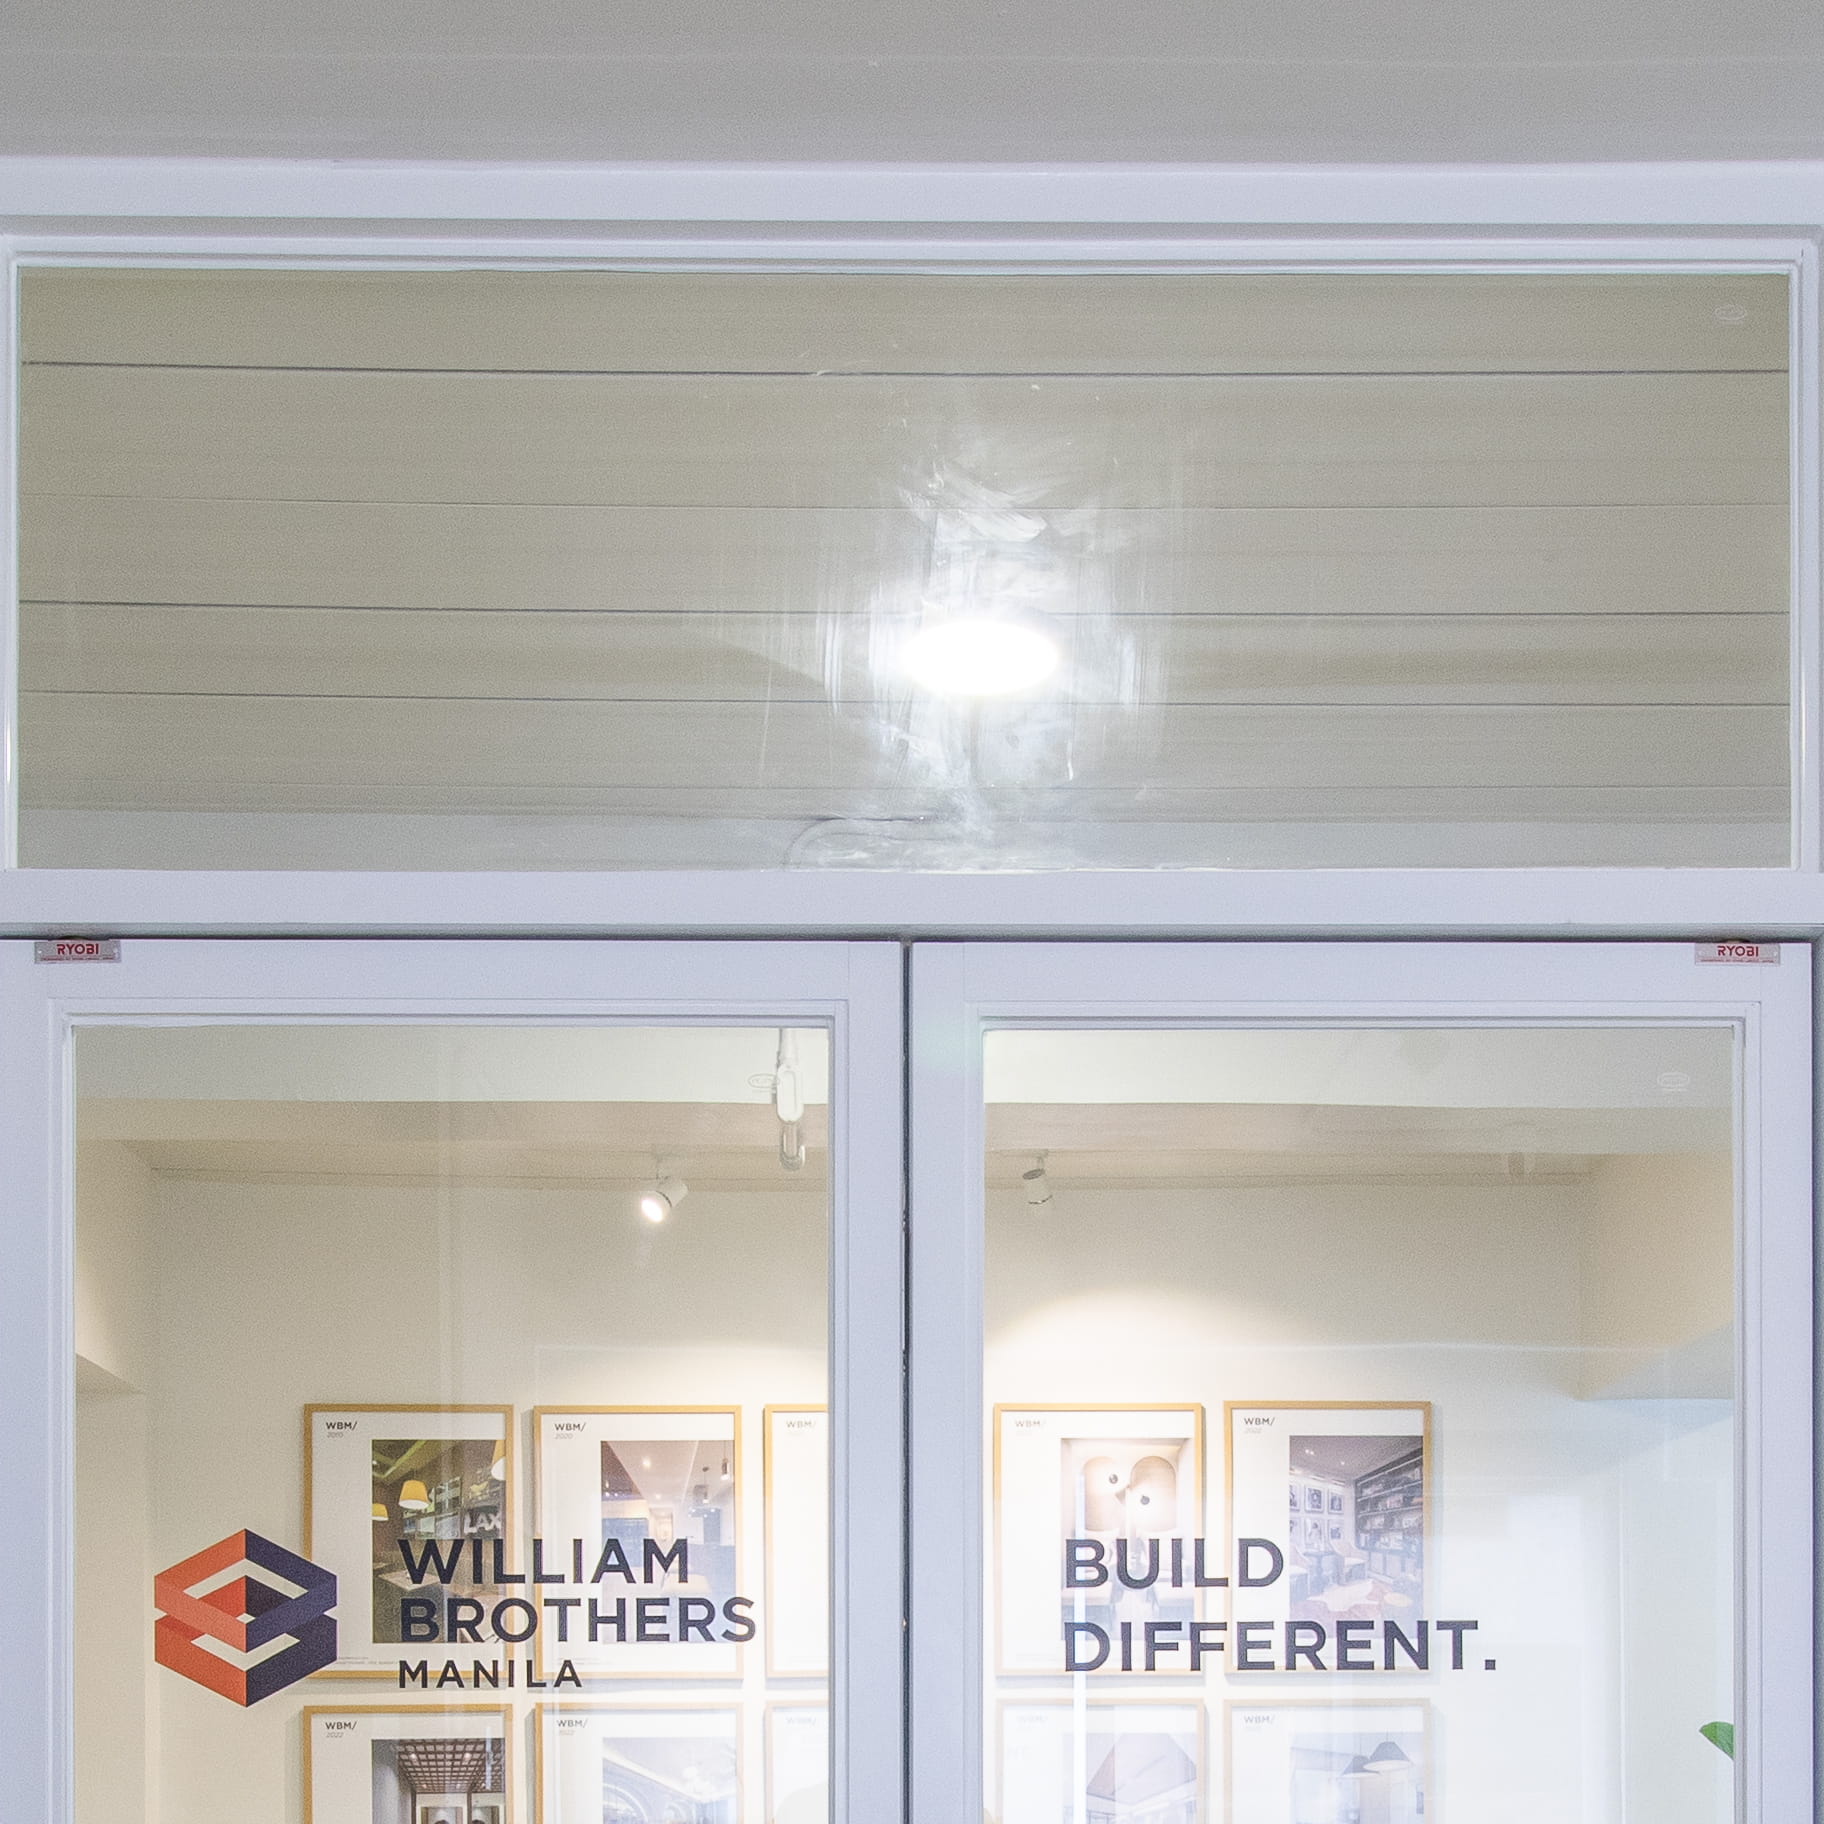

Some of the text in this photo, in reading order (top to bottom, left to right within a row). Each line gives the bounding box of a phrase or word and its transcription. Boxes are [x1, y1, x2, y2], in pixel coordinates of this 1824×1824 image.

[56, 943, 99, 955] RYOBI
[1717, 945, 1759, 957] RYOBI
[326, 1421, 357, 1431] WBM/
[554, 1422, 586, 1432] WBM/
[1244, 1416, 1275, 1426] WBM/
[397, 1538, 689, 1585] WILLIAM
[1065, 1537, 1285, 1589] BUILD
[400, 1596, 757, 1643] BROTHERS
[1065, 1620, 1497, 1672] DIFFERENT.
[398, 1660, 583, 1689] MANILA
[326, 1721, 357, 1730] WBM/
[556, 1718, 588, 1728] WBM/
